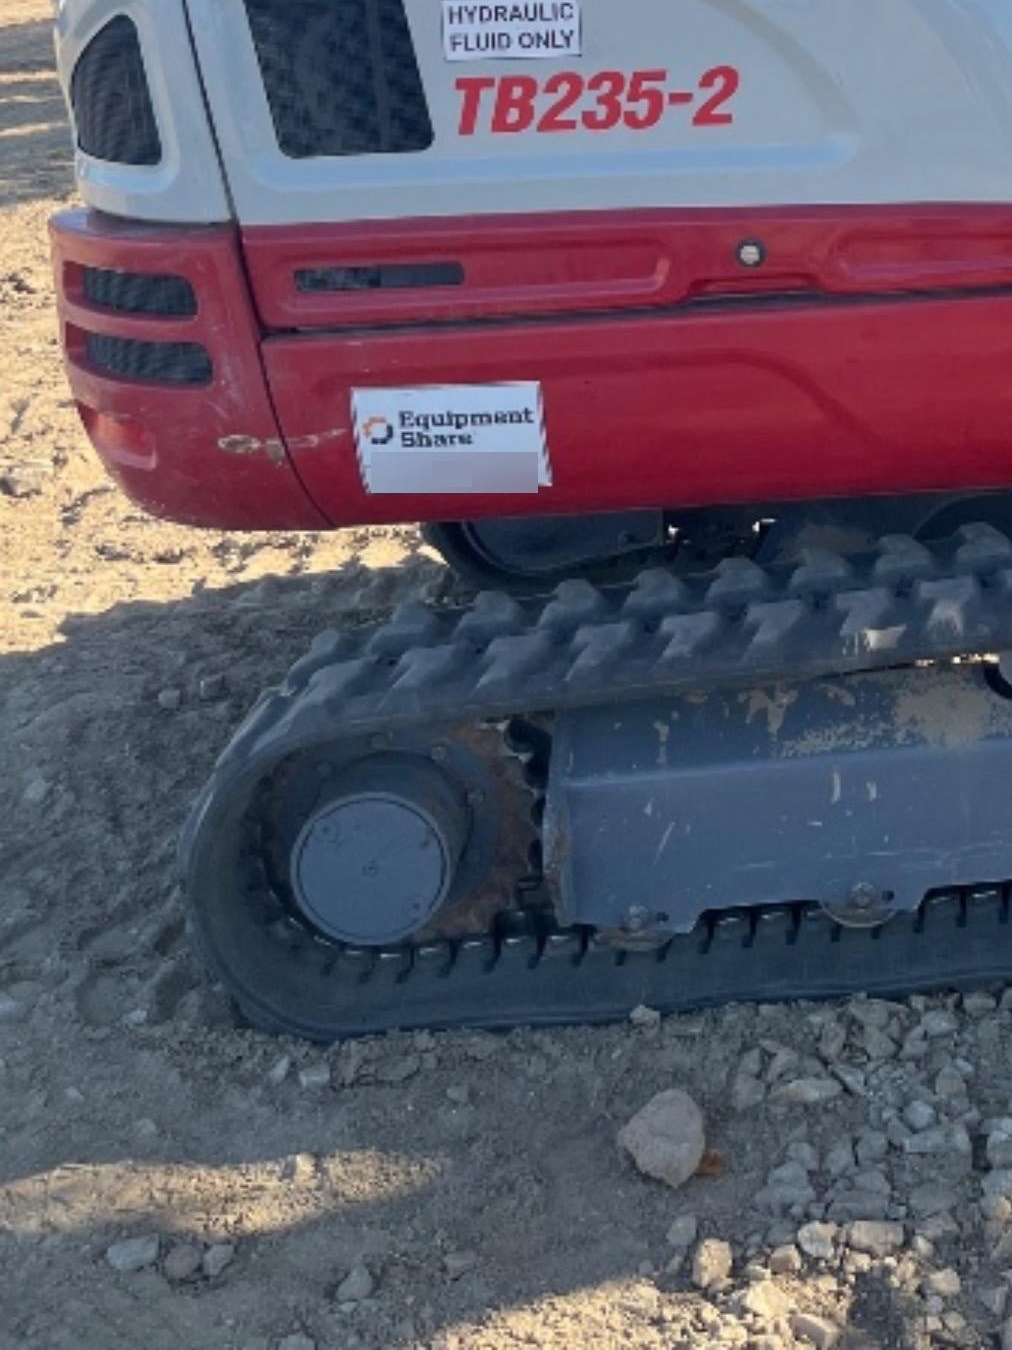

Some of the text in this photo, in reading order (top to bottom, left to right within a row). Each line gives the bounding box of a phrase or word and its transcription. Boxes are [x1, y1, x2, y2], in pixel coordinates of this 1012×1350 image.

[449, 2, 574, 24] HYDRAULIC
[451, 29, 574, 51] FLUID ONLY
[455, 65, 739, 135] TB235-2
[399, 407, 535, 430] Equipment
[400, 432, 474, 448] Share
